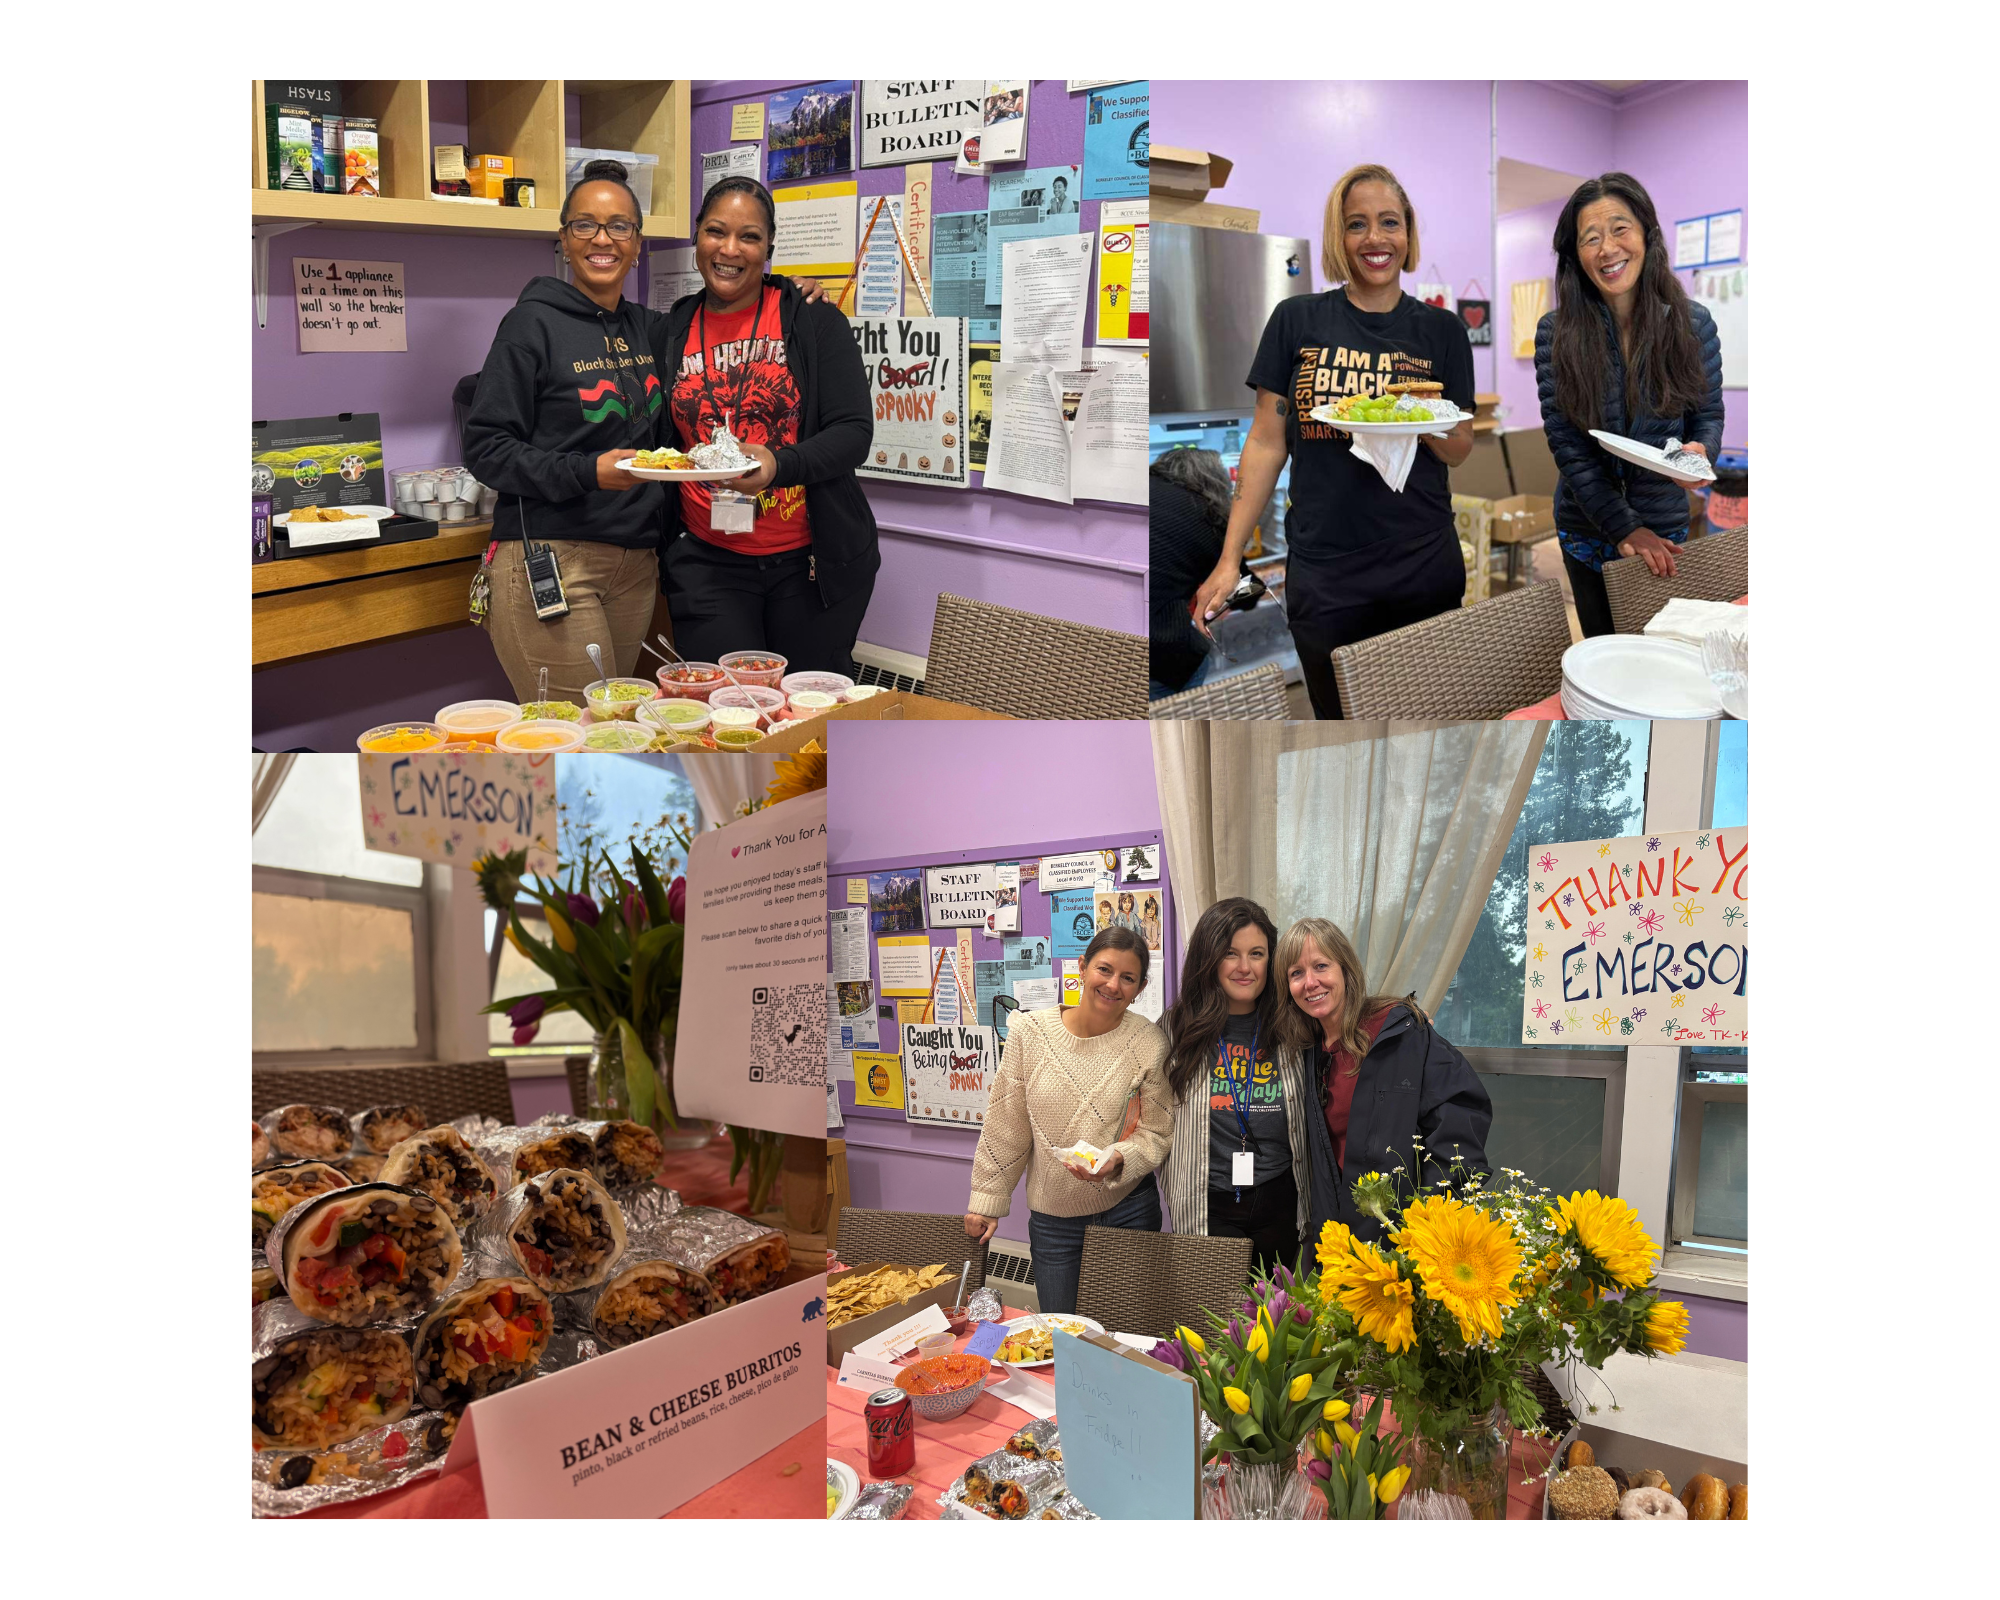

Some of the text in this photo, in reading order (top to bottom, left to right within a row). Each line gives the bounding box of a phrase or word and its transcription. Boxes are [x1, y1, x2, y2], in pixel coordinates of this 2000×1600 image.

[288, 86, 331, 102] STASH
[1103, 98, 1117, 107] We
[866, 98, 982, 129] BULLETIN
[351, 132, 371, 140] Orange
[880, 129, 962, 154] BOARD
[704, 155, 729, 167] BRTA
[1000, 178, 1033, 186] CLAREMONT
[301, 262, 394, 283] Use 1 appliance
[302, 283, 403, 298] at a time on this
[300, 298, 404, 314] wall so the breaker
[302, 317, 381, 335] doesn't go out.
[898, 320, 940, 356] You
[573, 357, 606, 374] Black
[1319, 346, 1392, 372] I AM A
[1391, 352, 1432, 369] INTELLIGENT
[1314, 368, 1392, 396] BLACK
[875, 390, 937, 421] SPOOKY
[756, 490, 779, 516] The
[390, 757, 534, 837] EMERSON
[743, 838, 772, 856] Thank
[775, 833, 796, 846] You
[799, 826, 815, 840] for
[704, 860, 822, 898] We hope you enjoyed today's staff
[941, 873, 981, 886] STAFF
[1537, 846, 1700, 930] THANK
[702, 876, 825, 910] families love providing these meals.
[764, 898, 773, 907] us
[775, 893, 795, 905] keep
[797, 889, 818, 901] them
[930, 890, 995, 904] BULLETIN
[940, 908, 986, 920] BOARD
[701, 914, 823, 942] Please scan below to share a quick
[754, 928, 827, 945] favorite dish of you
[725, 964, 738, 972] (only
[739, 962, 754, 970] takes
[755, 961, 772, 969] about
[781, 956, 806, 966] seconds
[807, 954, 819, 963] and
[907, 1025, 954, 1049] Caught
[958, 1027, 983, 1050] You
[1674, 1028, 1706, 1041] Love
[912, 1050, 946, 1075] Being
[950, 1072, 983, 1092] SPOOKY
[1214, 1067, 1229, 1079] a
[883, 1336, 902, 1347] Thank
[903, 1328, 914, 1336] you
[857, 1369, 876, 1378] CARNITAS
[1072, 1362, 1112, 1406] Drinks
[559, 1341, 802, 1469] BEAN & CHEESE BURRITOS
[572, 1363, 799, 1487] pinto, black or refried beans, rice, cheese, pico de gallo
[1085, 1414, 1125, 1456] Fridge
